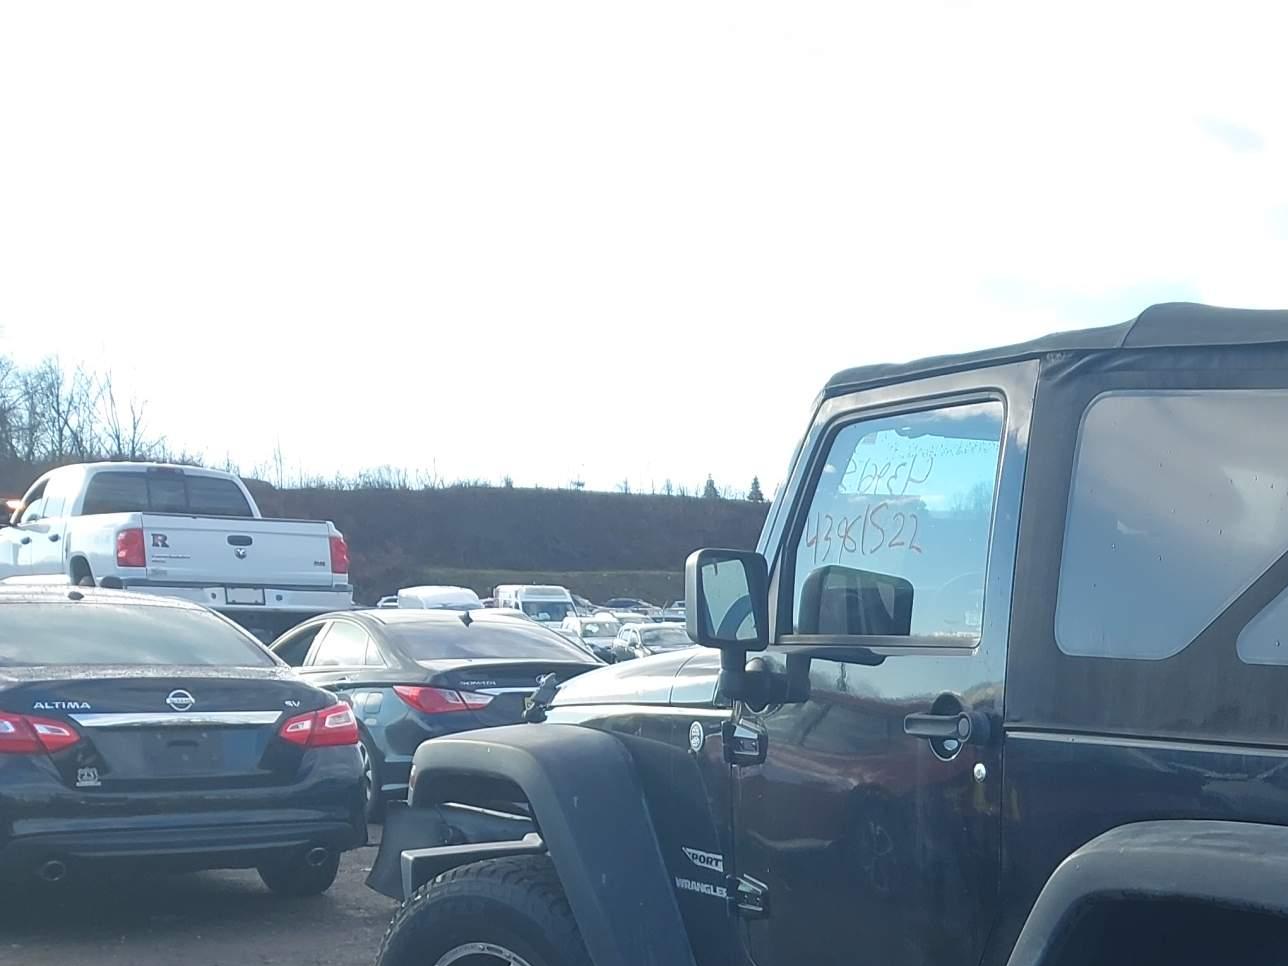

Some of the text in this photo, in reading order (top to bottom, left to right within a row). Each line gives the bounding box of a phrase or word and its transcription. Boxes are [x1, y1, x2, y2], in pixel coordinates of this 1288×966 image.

[151, 533, 169, 548] R
[804, 502, 923, 565] 43961522
[33, 701, 91, 709] ALTIMA
